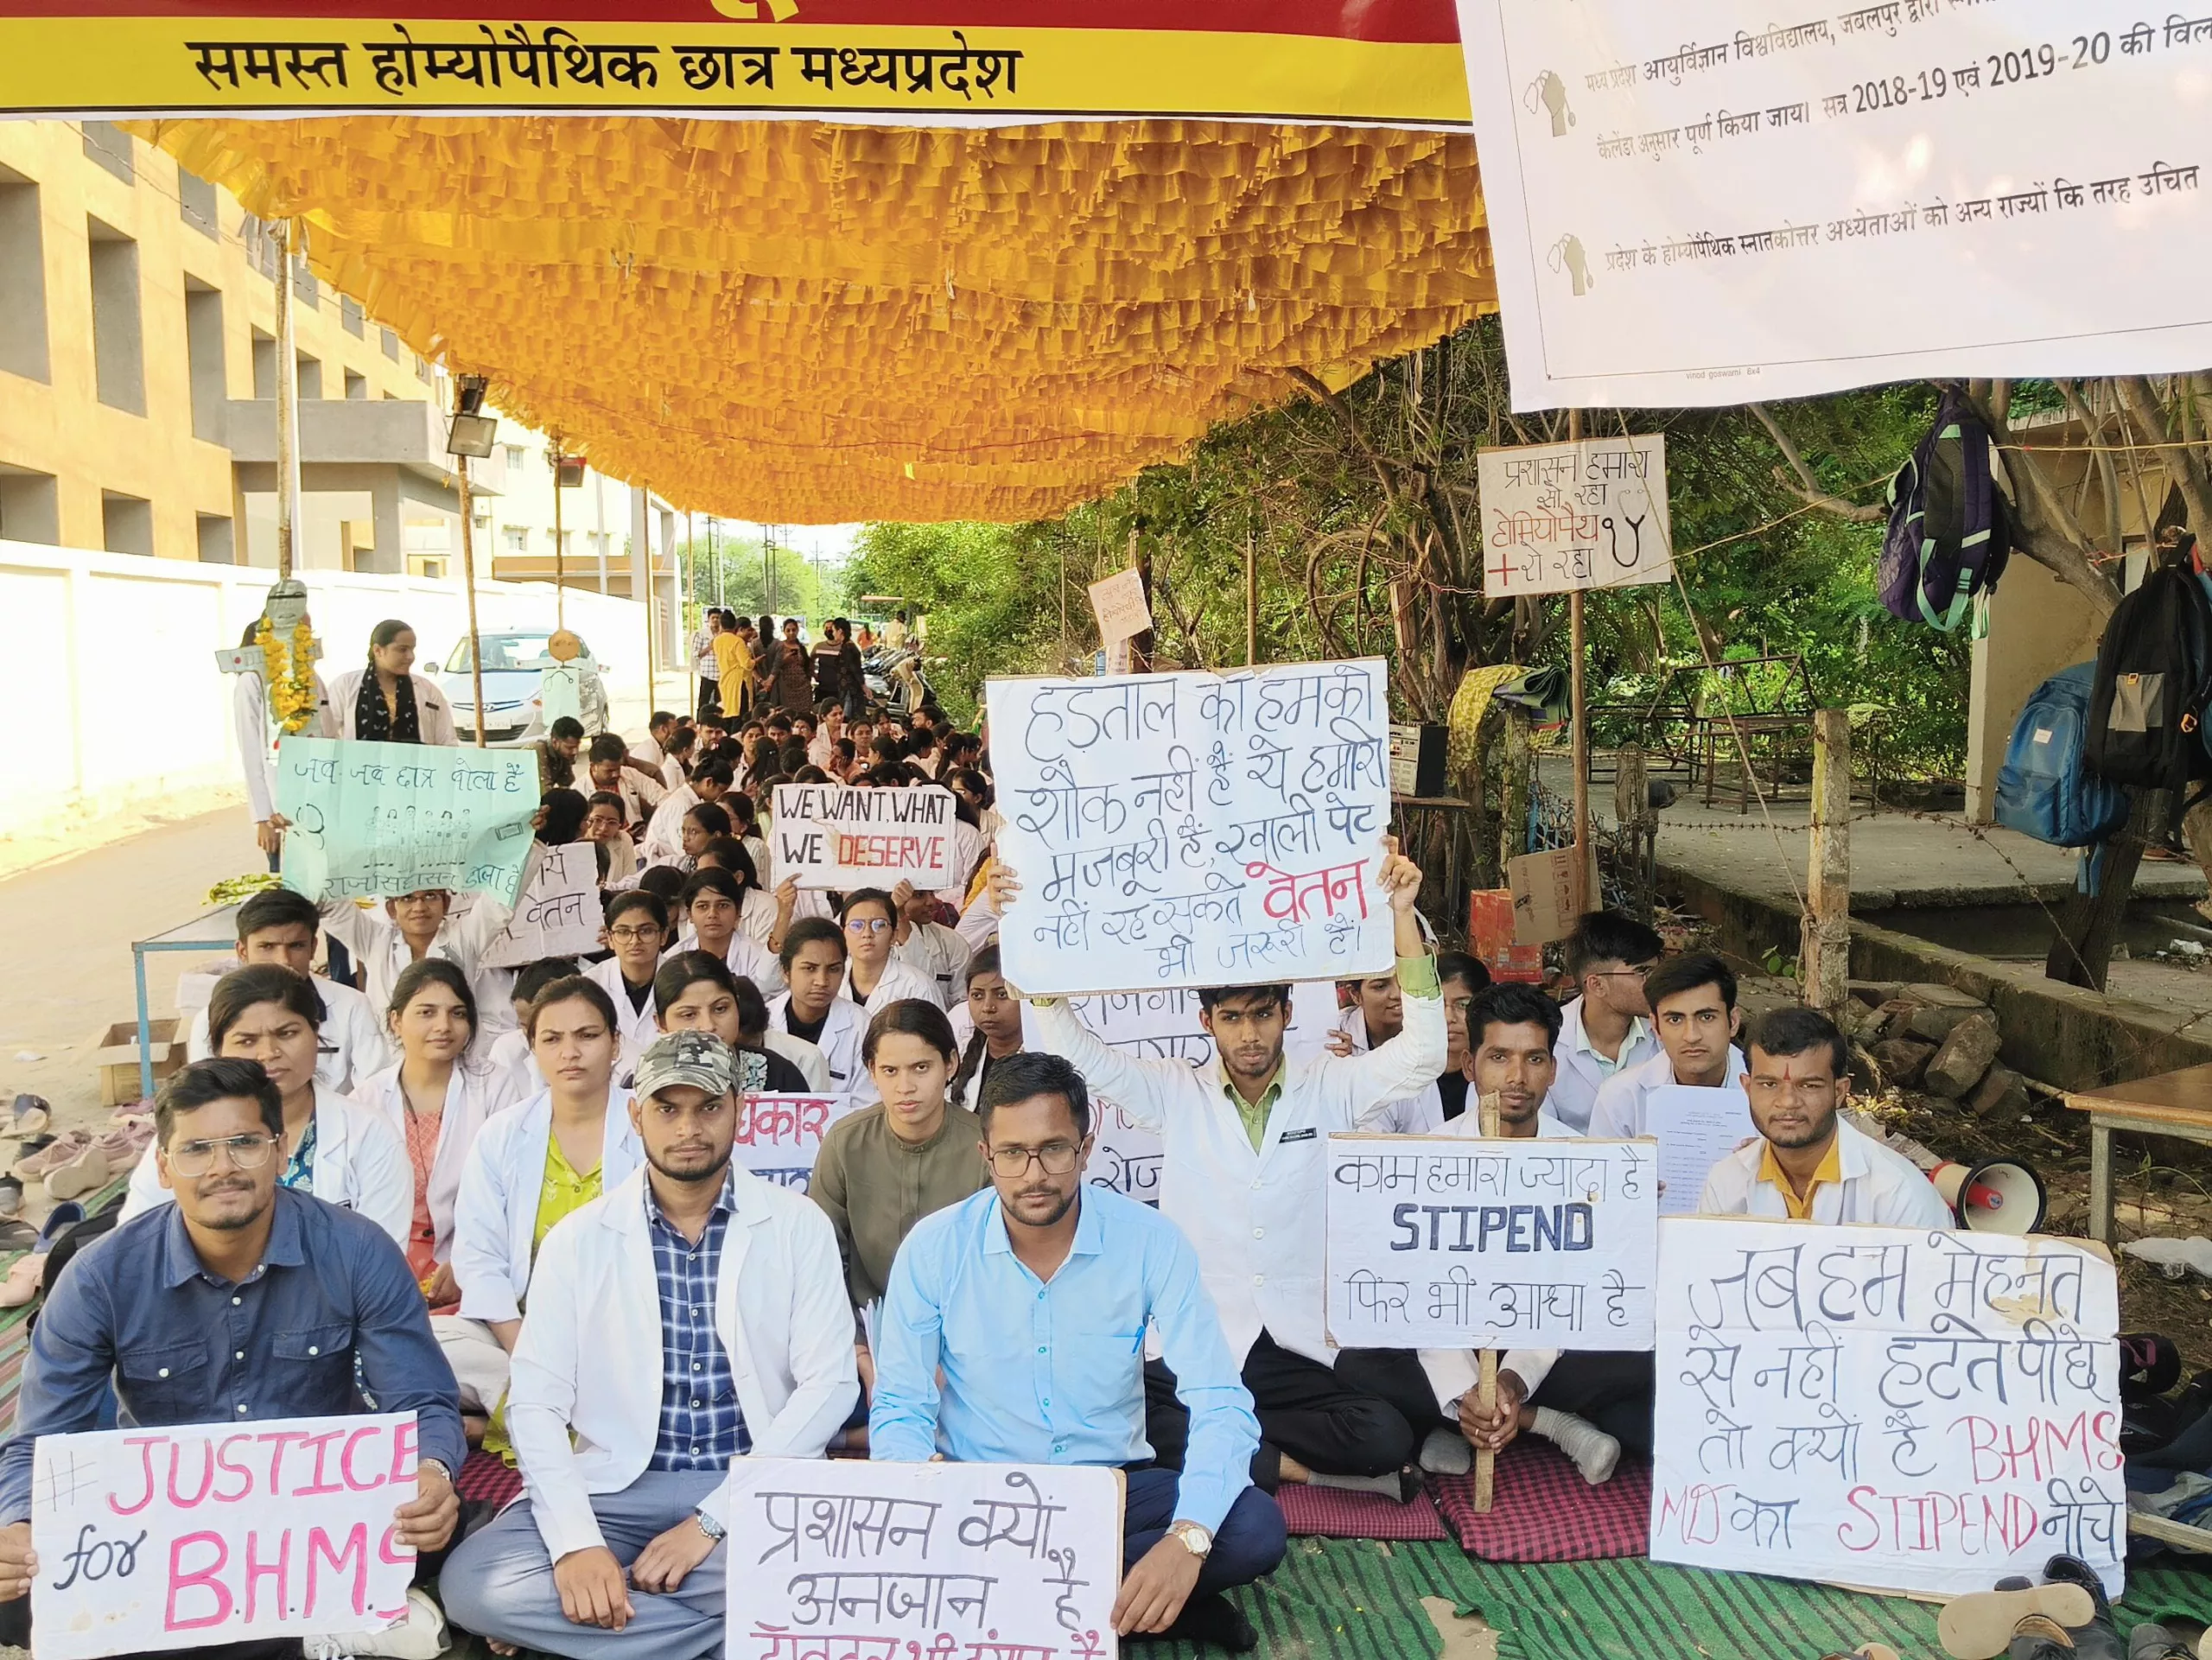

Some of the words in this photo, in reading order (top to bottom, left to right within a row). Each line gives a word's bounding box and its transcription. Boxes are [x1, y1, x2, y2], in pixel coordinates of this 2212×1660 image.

[184, 41, 351, 89] समस्त
[362, 22, 660, 97] होम्योपैथिक
[672, 46, 775, 92] छात्र
[791, 29, 1025, 101] मध्यप्रदेश
[1643, 41, 1728, 86] आयुर्विज्ञान
[1734, 20, 1836, 62] विश्वविद्यालय,
[1837, 2, 1902, 38] जबलपुर
[1638, 128, 1681, 162] अनुसार
[1685, 112, 1713, 155] पूर्ण
[1719, 109, 1760, 139] किया
[1821, 94, 1848, 118] सत्र
[1852, 67, 1948, 113] 2018-19
[1952, 60, 1981, 98] एवं
[1986, 31, 2110, 87] 2019-20
[2119, 22, 2156, 56] की
[1605, 243, 1637, 271] प्रदेश
[1642, 239, 1657, 266] के
[1662, 229, 1736, 267] होम्योपैथिक
[1738, 219, 1821, 254] स्नातकोत्तर
[1923, 194, 1949, 227] को
[1955, 198, 1993, 225] अन्य
[1998, 181, 2049, 219] राज्यों
[2052, 176, 2085, 212] कि
[2090, 176, 2132, 205] तरह
[2137, 160, 2200, 198] उचित
[1503, 452, 1578, 488] प्रशासन
[1586, 450, 1652, 480] हमारा
[1536, 480, 1562, 508] सो
[1574, 483, 1608, 506] रहा
[1521, 541, 1543, 582] रो
[1553, 548, 1594, 580] रहा
[1196, 676, 1255, 735] का
[1255, 664, 1371, 732] हमको
[779, 788, 815, 819] WE
[892, 792, 952, 824] WHAT
[1014, 760, 1127, 849] शौक
[1131, 745, 1199, 816] नहीं
[1246, 734, 1294, 805] ये
[1300, 716, 1387, 793] हमारी
[782, 832, 823, 864] WE
[837, 834, 945, 869] DESERVE
[1042, 817, 1169, 902] मजबूरी
[1216, 793, 1321, 867] खाली
[1325, 792, 1376, 847] पेट
[525, 893, 587, 932] वेतन
[1033, 899, 1090, 951] नहीं
[1245, 858, 1370, 924] वेतन
[1143, 933, 1197, 979] भी
[1334, 1154, 1423, 1194] काम
[1427, 1156, 1511, 1197] हमारा
[1520, 1156, 1610, 1202] ज्यादा
[1620, 1144, 1649, 1200] है
[1389, 1203, 1593, 1252] STIPEND
[1343, 1269, 1410, 1324] फिर
[1427, 1264, 1478, 1326] भी
[1484, 1282, 1588, 1332] आधा
[1602, 1268, 1646, 1327] है
[1688, 1243, 1807, 1332] जब
[1817, 1243, 1913, 1323] हम
[1927, 1230, 2084, 1324] मेहनत
[1679, 1324, 1741, 1409] से
[1754, 1319, 1845, 1403] नहीं
[1877, 1312, 2012, 1409] हटते
[2017, 1316, 2112, 1404] पीछे
[105, 1420, 419, 1517] JUSTICE
[1698, 1408, 1752, 1475] तो
[1769, 1402, 1864, 1483] क्यों
[1882, 1409, 1938, 1478] है
[1946, 1409, 2123, 1485] BHMS
[53, 1523, 147, 1591] for
[754, 1491, 943, 1566] प्रशासन
[957, 1471, 1067, 1560] क्यों
[1657, 1483, 1738, 1545] MD
[1731, 1491, 1801, 1549] का
[1837, 1485, 2038, 1556] STIPEND
[2042, 1476, 2125, 1562] नीचे
[787, 1571, 999, 1631] अनजान
[1042, 1547, 1090, 1631] है
